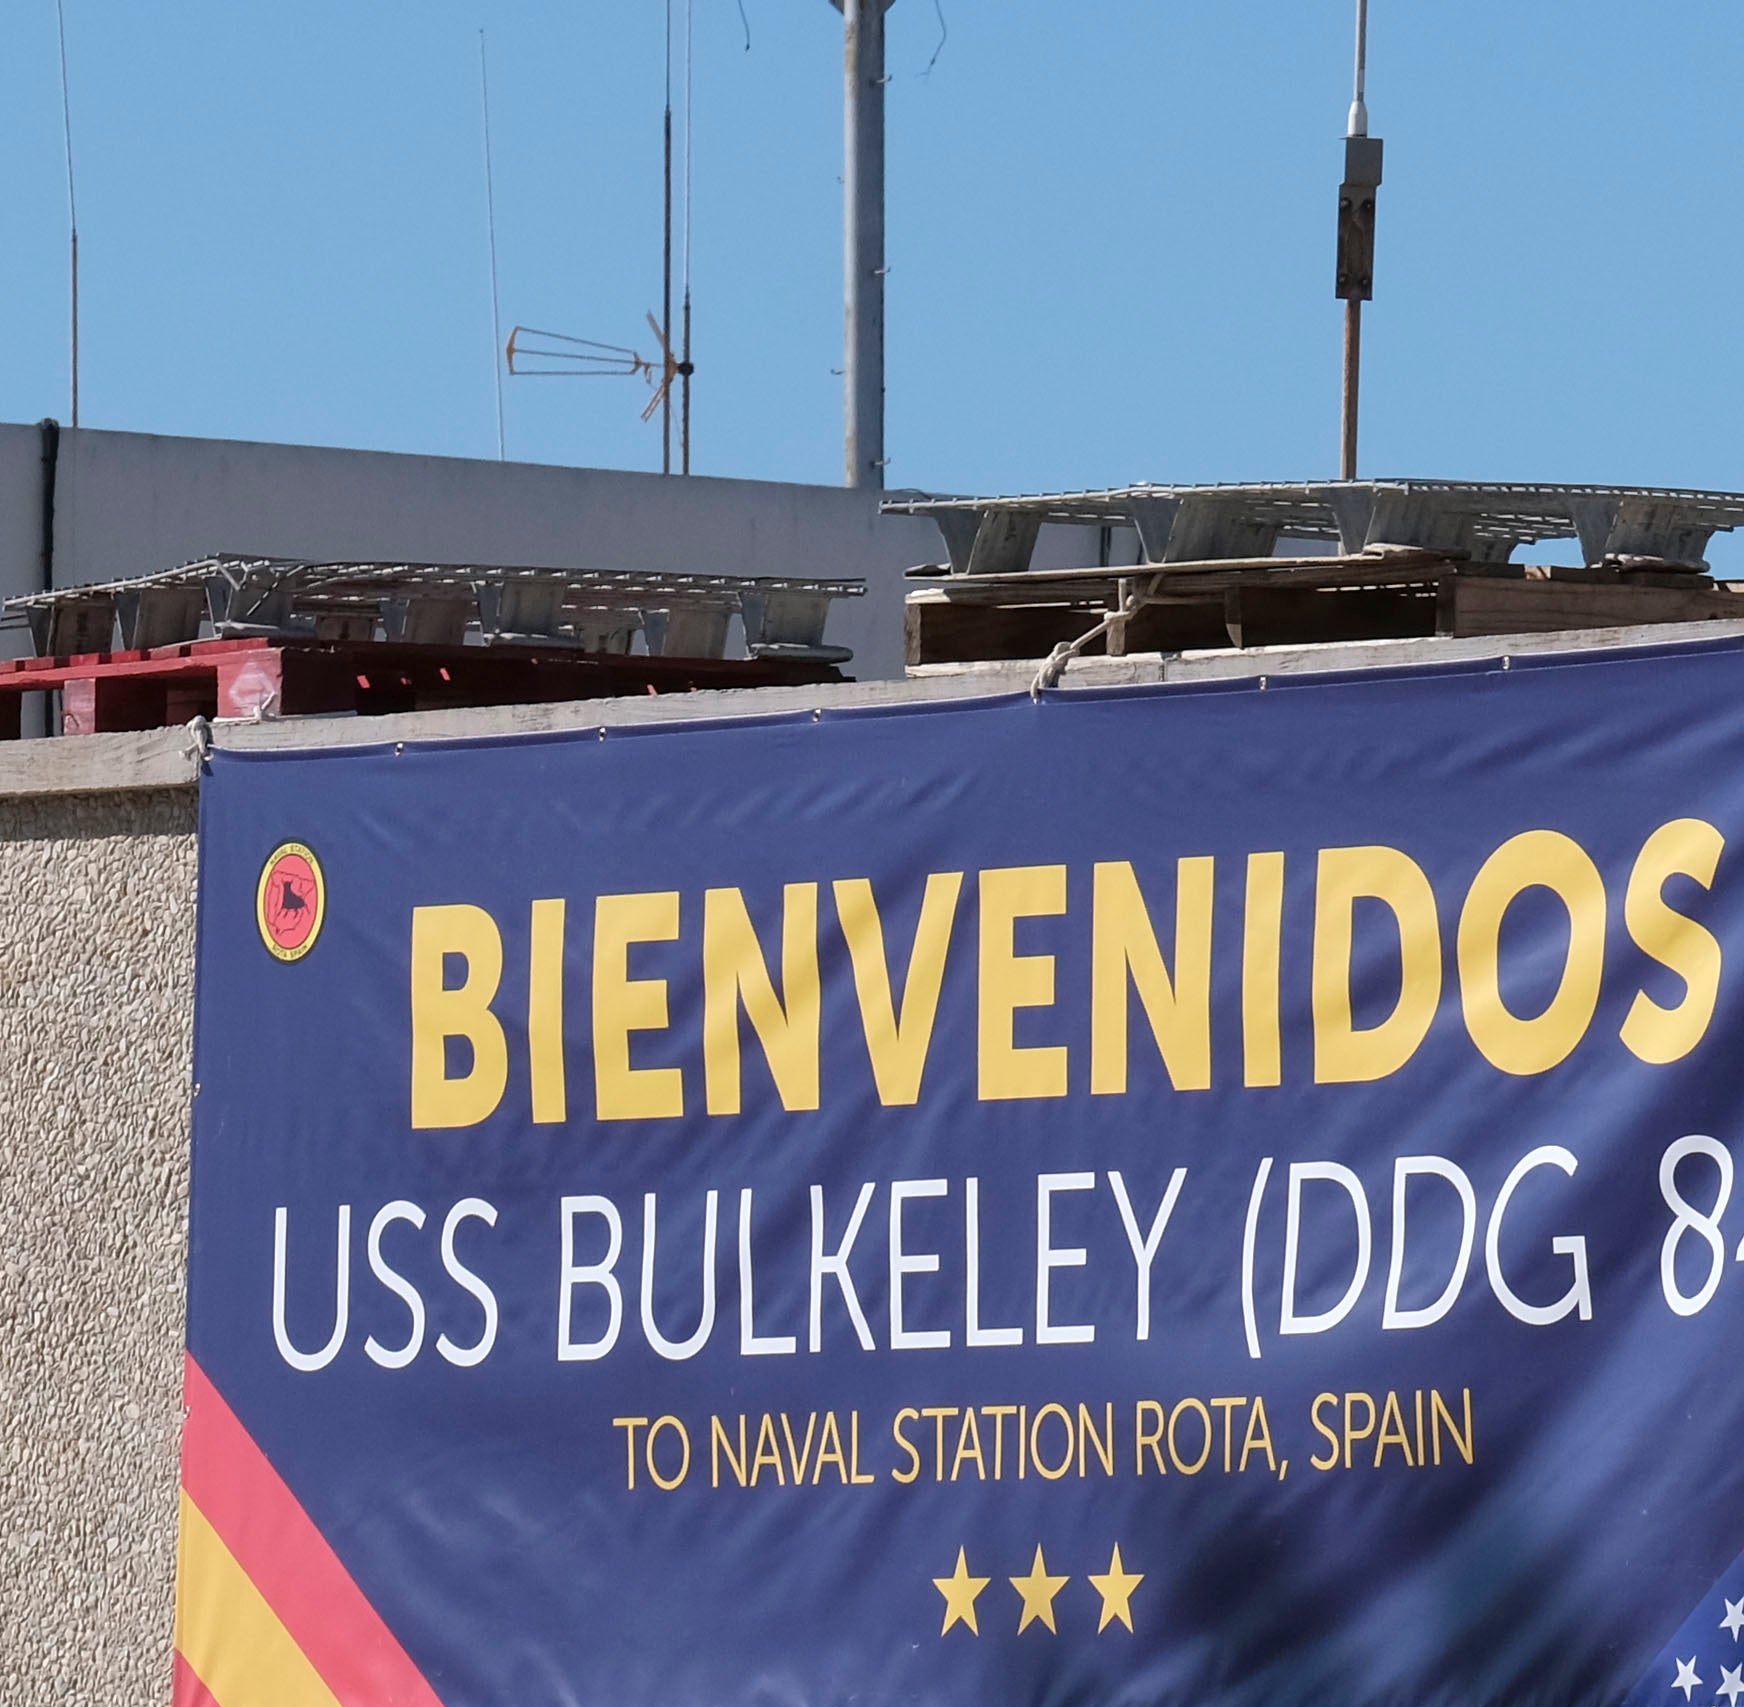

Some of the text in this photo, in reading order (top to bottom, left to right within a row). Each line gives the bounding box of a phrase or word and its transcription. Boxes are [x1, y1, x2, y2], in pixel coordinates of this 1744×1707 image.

[409, 817, 1726, 1131] BIENVENIDOS
[270, 1196, 500, 1373] USS
[556, 1166, 1189, 1363] BULKELEY
[1240, 1144, 1594, 1360] (DDG
[612, 1387, 1475, 1492] TO NAVAL STATION ROTA, SPAIN
